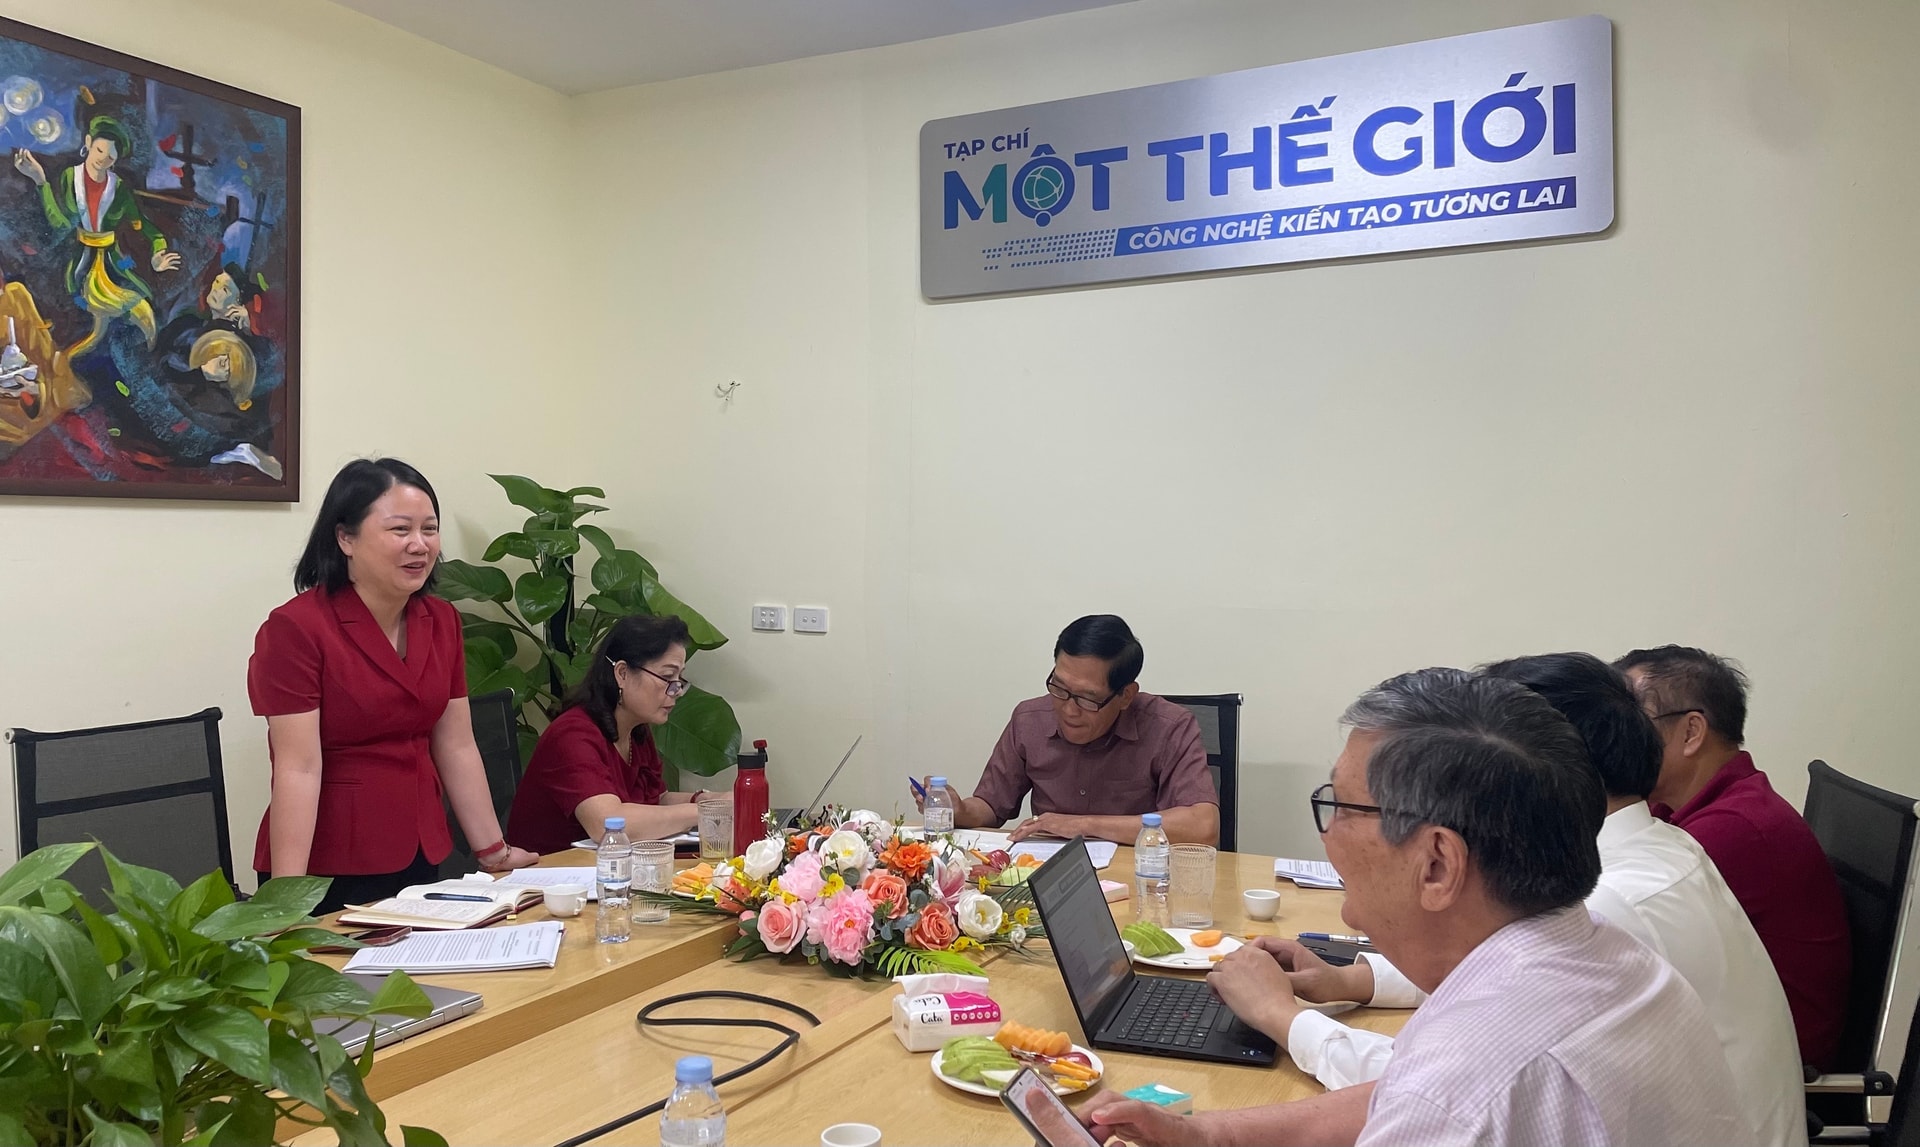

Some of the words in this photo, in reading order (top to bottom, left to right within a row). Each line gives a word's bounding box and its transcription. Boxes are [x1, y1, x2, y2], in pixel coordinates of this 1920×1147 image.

[944, 139, 985, 161] TẠP
[991, 127, 1030, 152] CHÍ
[944, 144, 1128, 227] MỘT
[1148, 95, 1337, 201] THẾ
[1353, 71, 1576, 176] GIỚI
[1129, 227, 1197, 250] CÔNG
[1203, 213, 1273, 240] NGHỆ
[1279, 205, 1340, 233] KIẾN
[1348, 203, 1402, 229] TẠO
[1410, 191, 1511, 218] TƯƠNG
[1517, 185, 1565, 208] LAI
[921, 1012, 943, 1024] Cata
